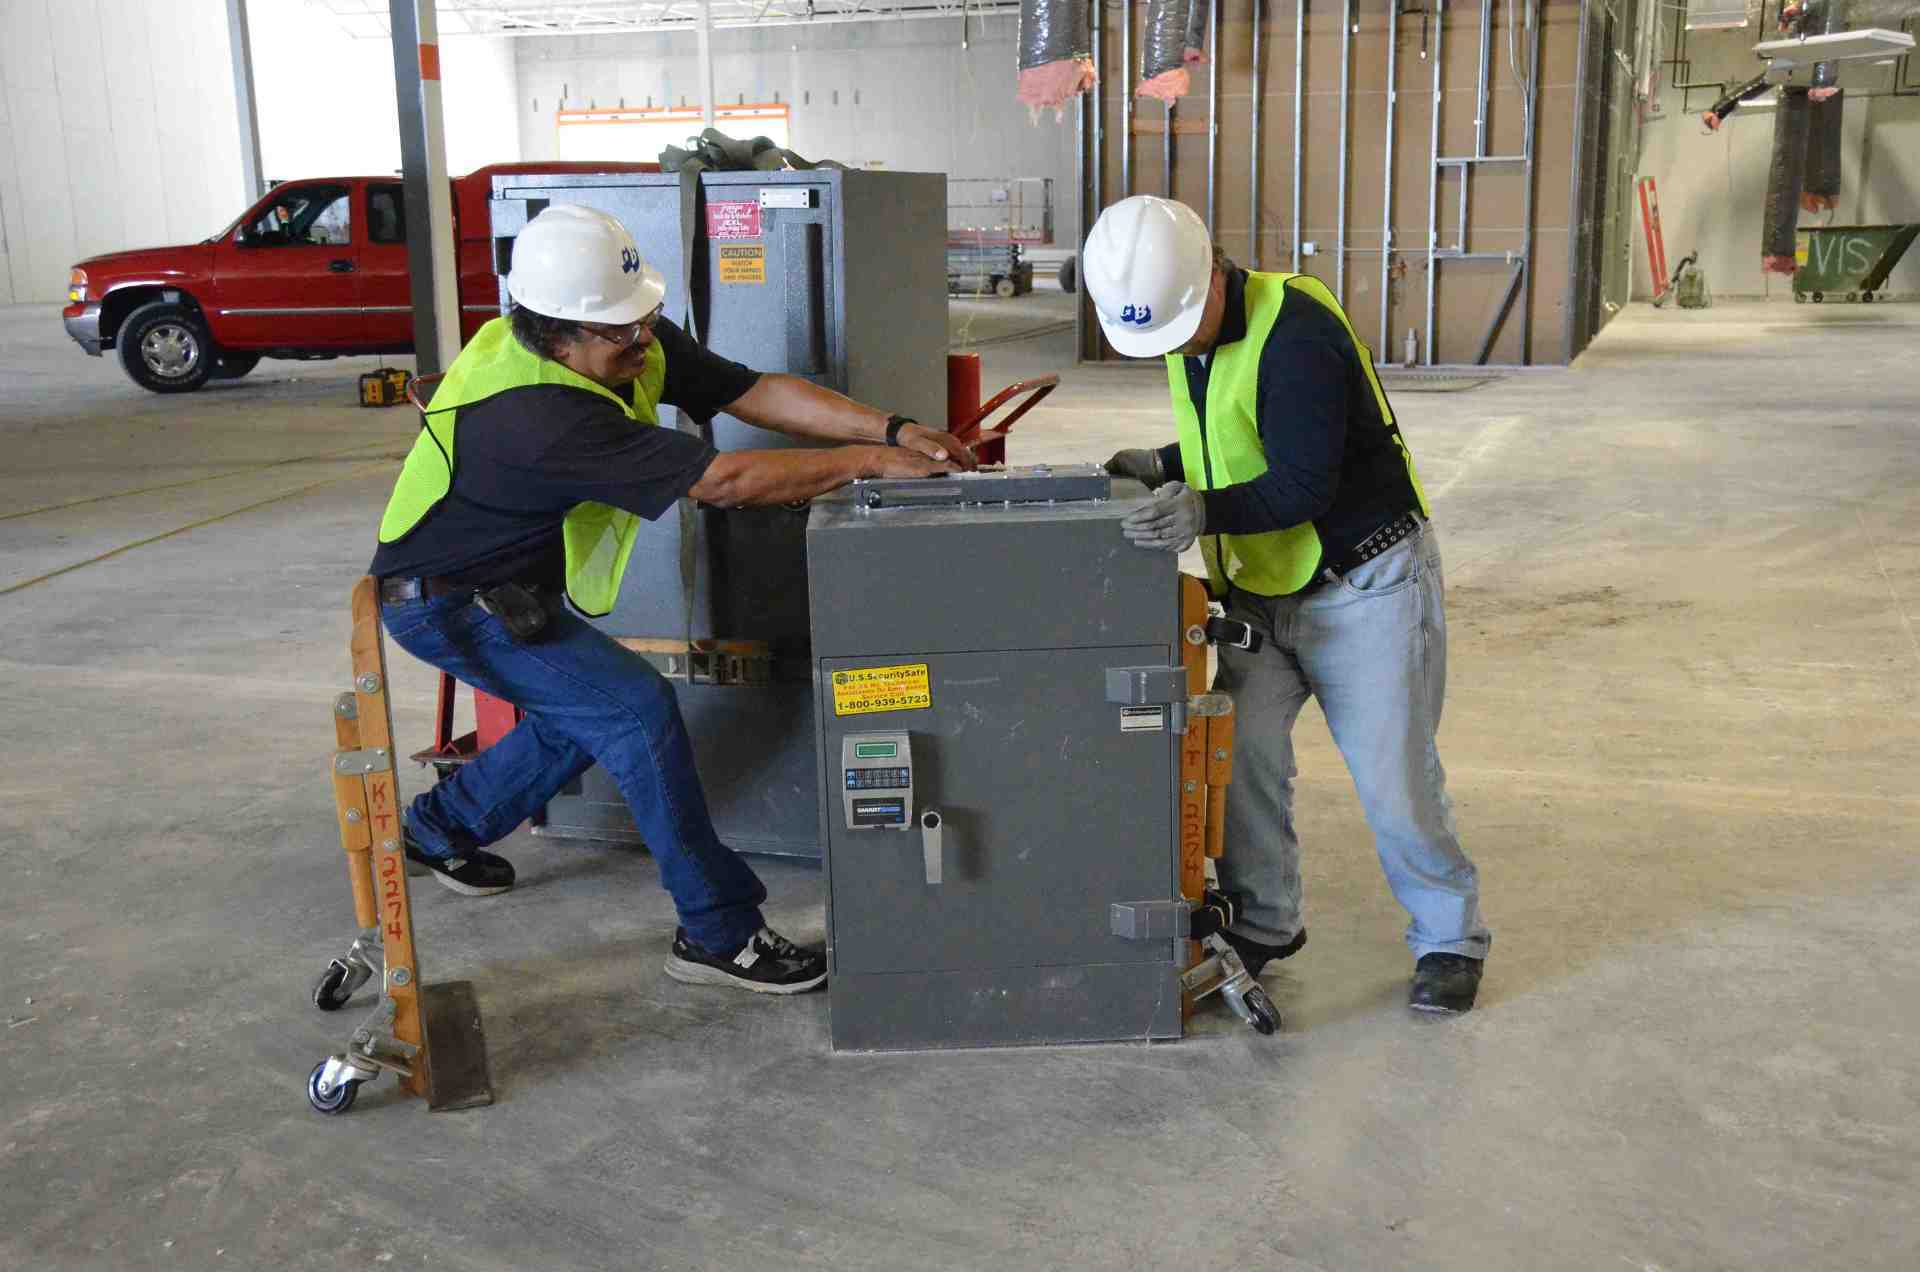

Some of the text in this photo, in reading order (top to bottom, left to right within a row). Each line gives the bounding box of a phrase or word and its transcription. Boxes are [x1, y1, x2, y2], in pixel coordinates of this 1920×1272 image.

[720, 248, 762, 257] CAUTION
[1814, 232, 1873, 276] VIS
[838, 694, 929, 710] 1-800-939-5723
